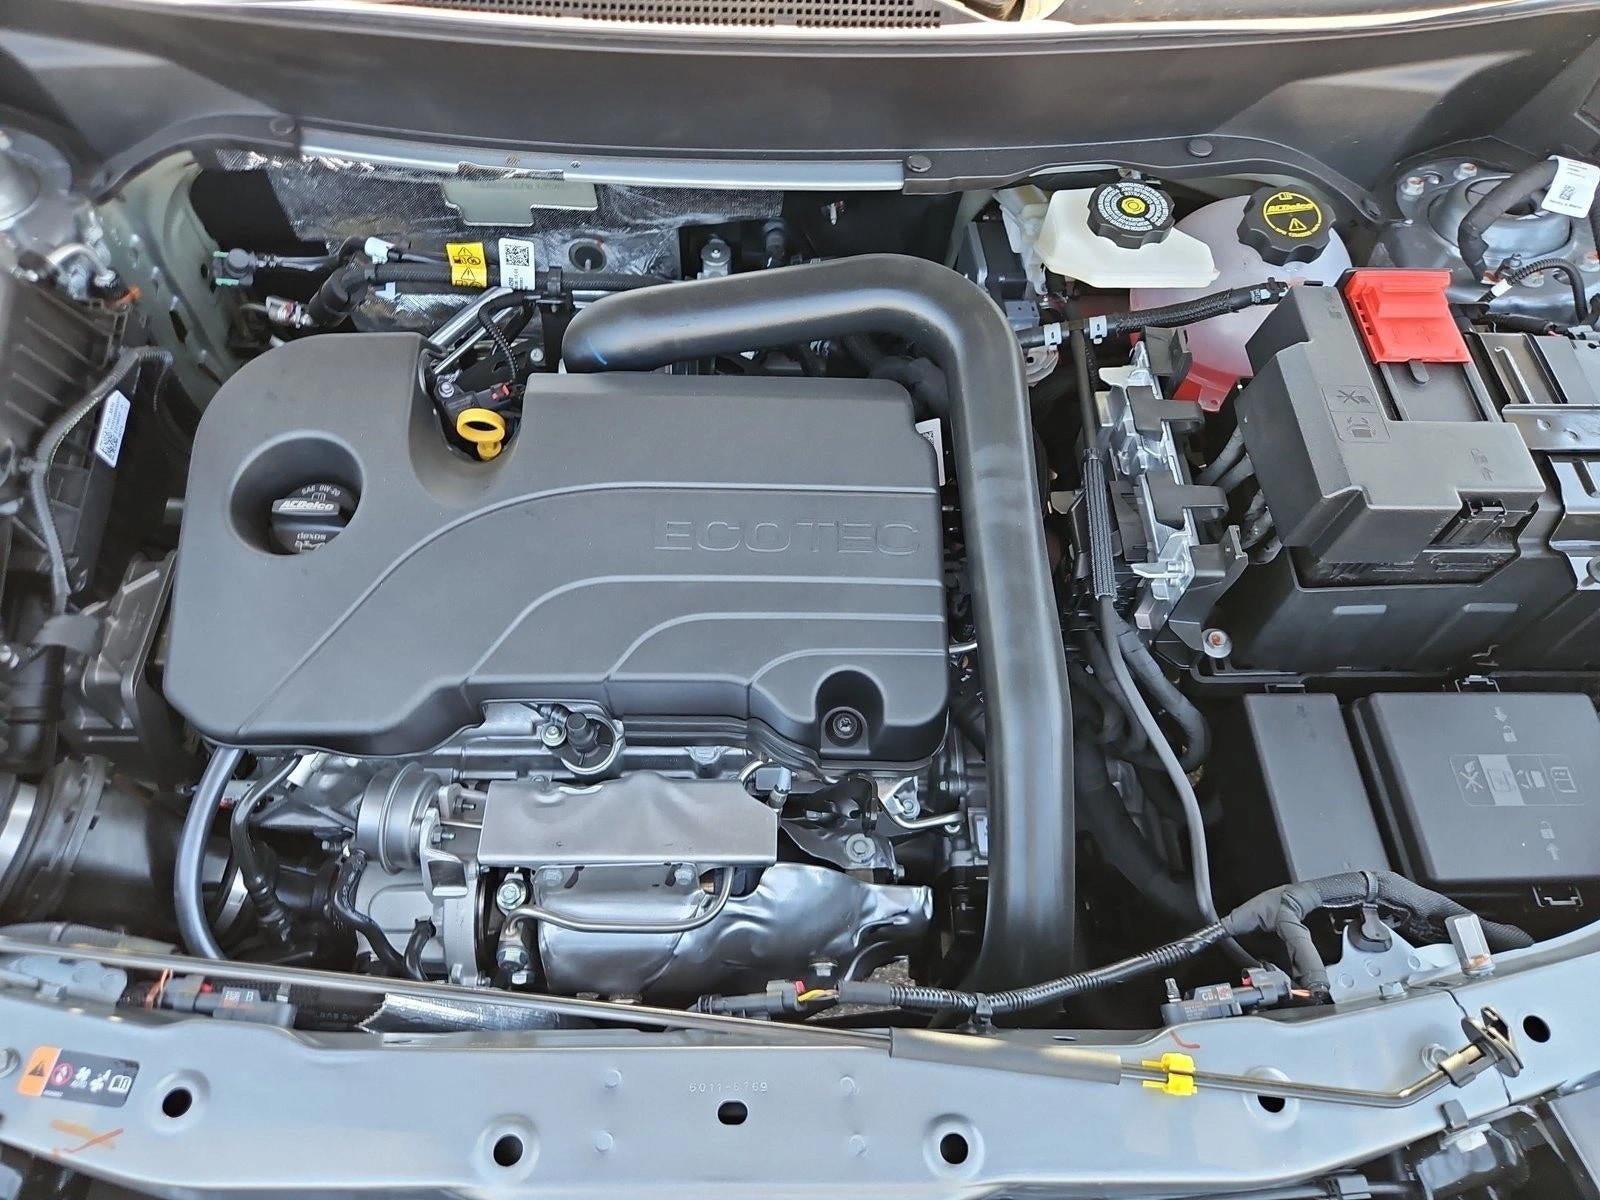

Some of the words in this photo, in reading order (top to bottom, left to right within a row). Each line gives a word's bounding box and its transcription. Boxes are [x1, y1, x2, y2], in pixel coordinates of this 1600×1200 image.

[301, 484, 316, 495] SAE
[319, 484, 341, 497] 0W-20
[279, 501, 334, 511] ACDelco
[653, 521, 920, 556] ECOTEC
